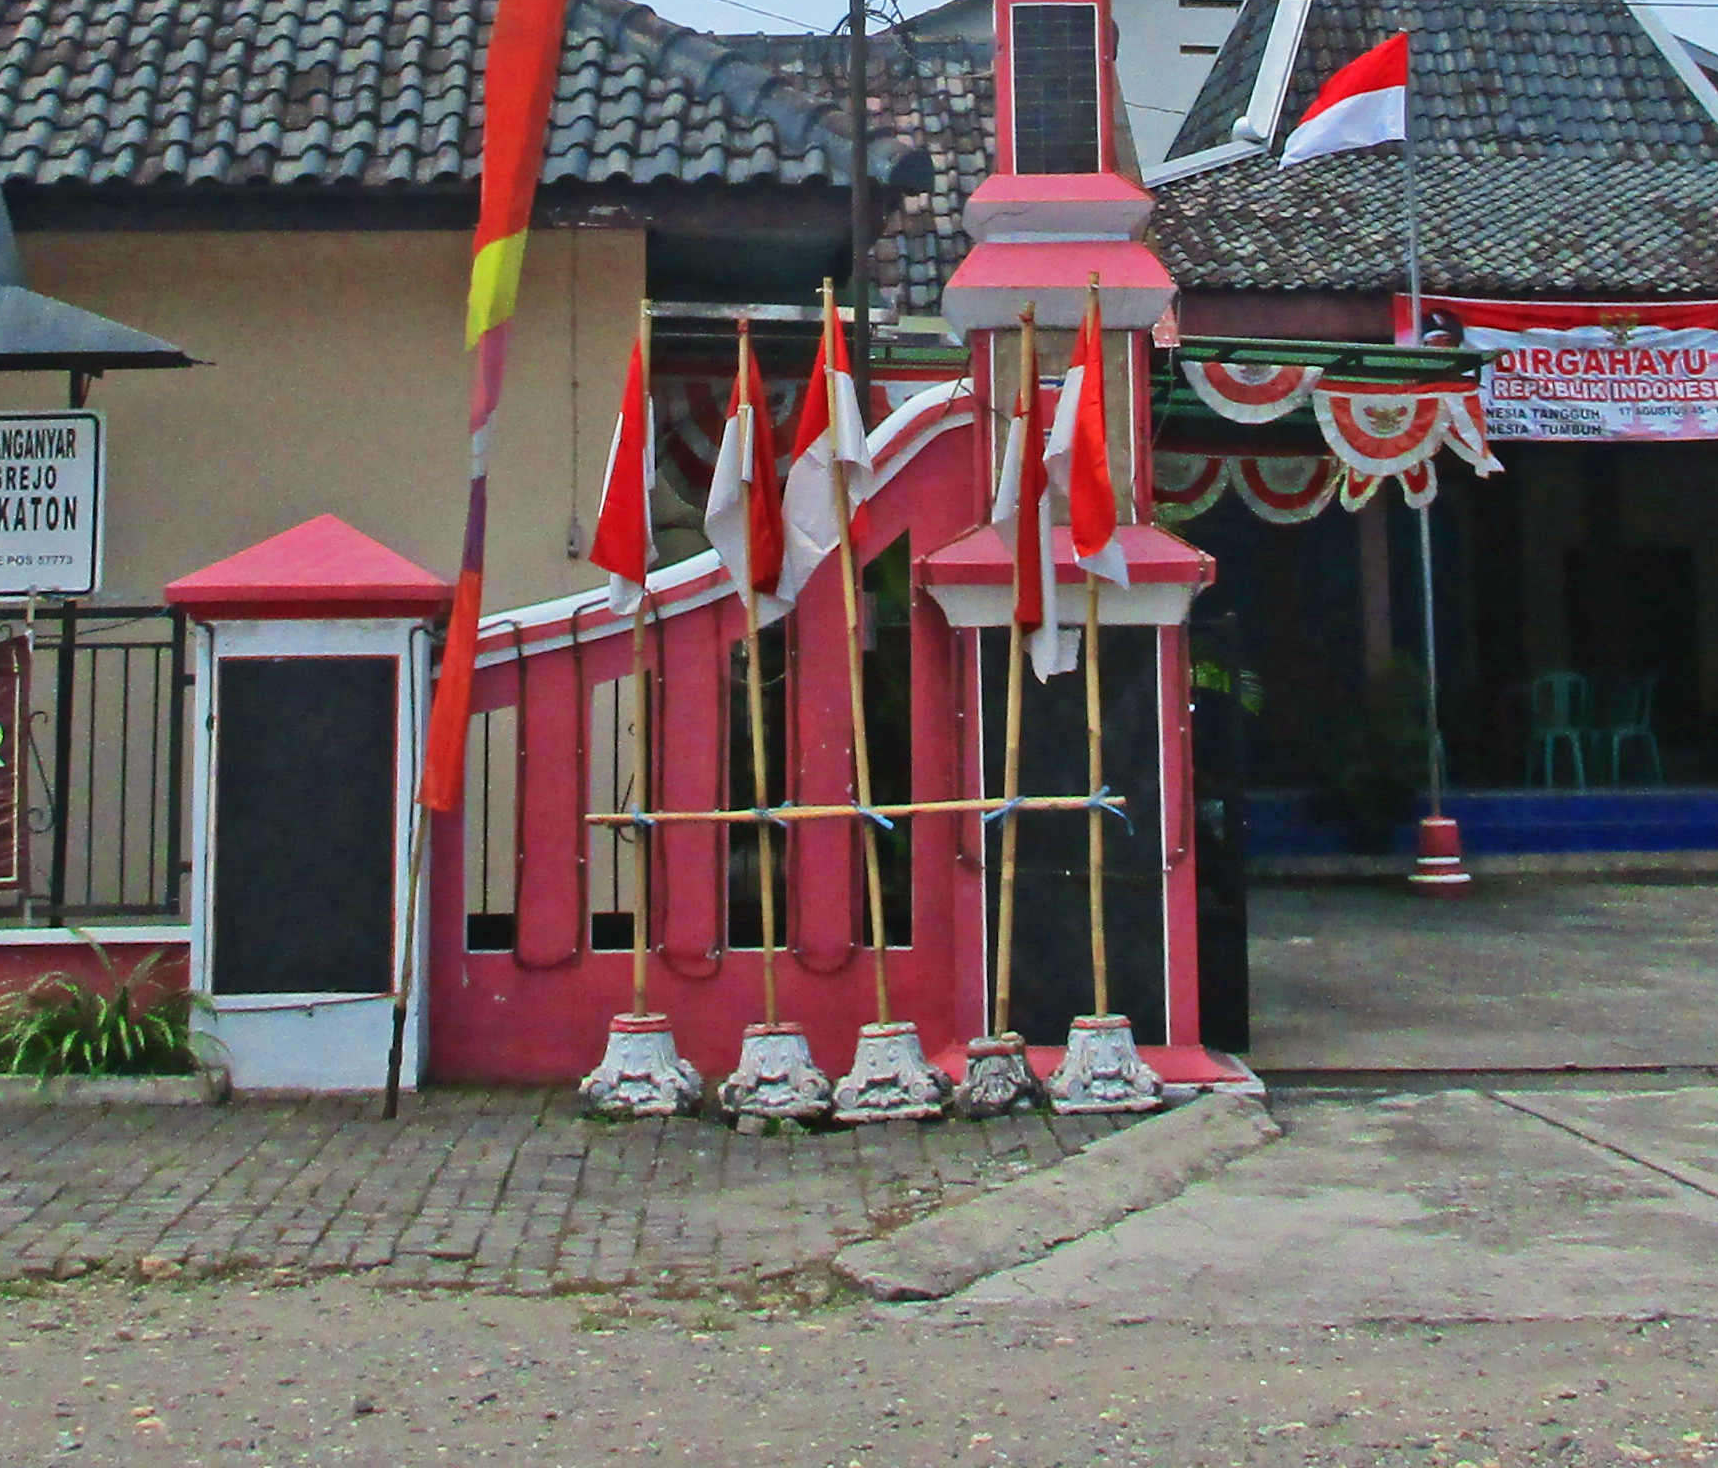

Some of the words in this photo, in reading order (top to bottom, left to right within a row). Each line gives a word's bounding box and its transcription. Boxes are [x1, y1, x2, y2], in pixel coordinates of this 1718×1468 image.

[1494, 348, 1708, 375] DIRGAHAYU
[1492, 379, 1610, 400] REPUBLIK
[1533, 407, 1600, 420] TANGGUH
[7, 554, 33, 566] POS
